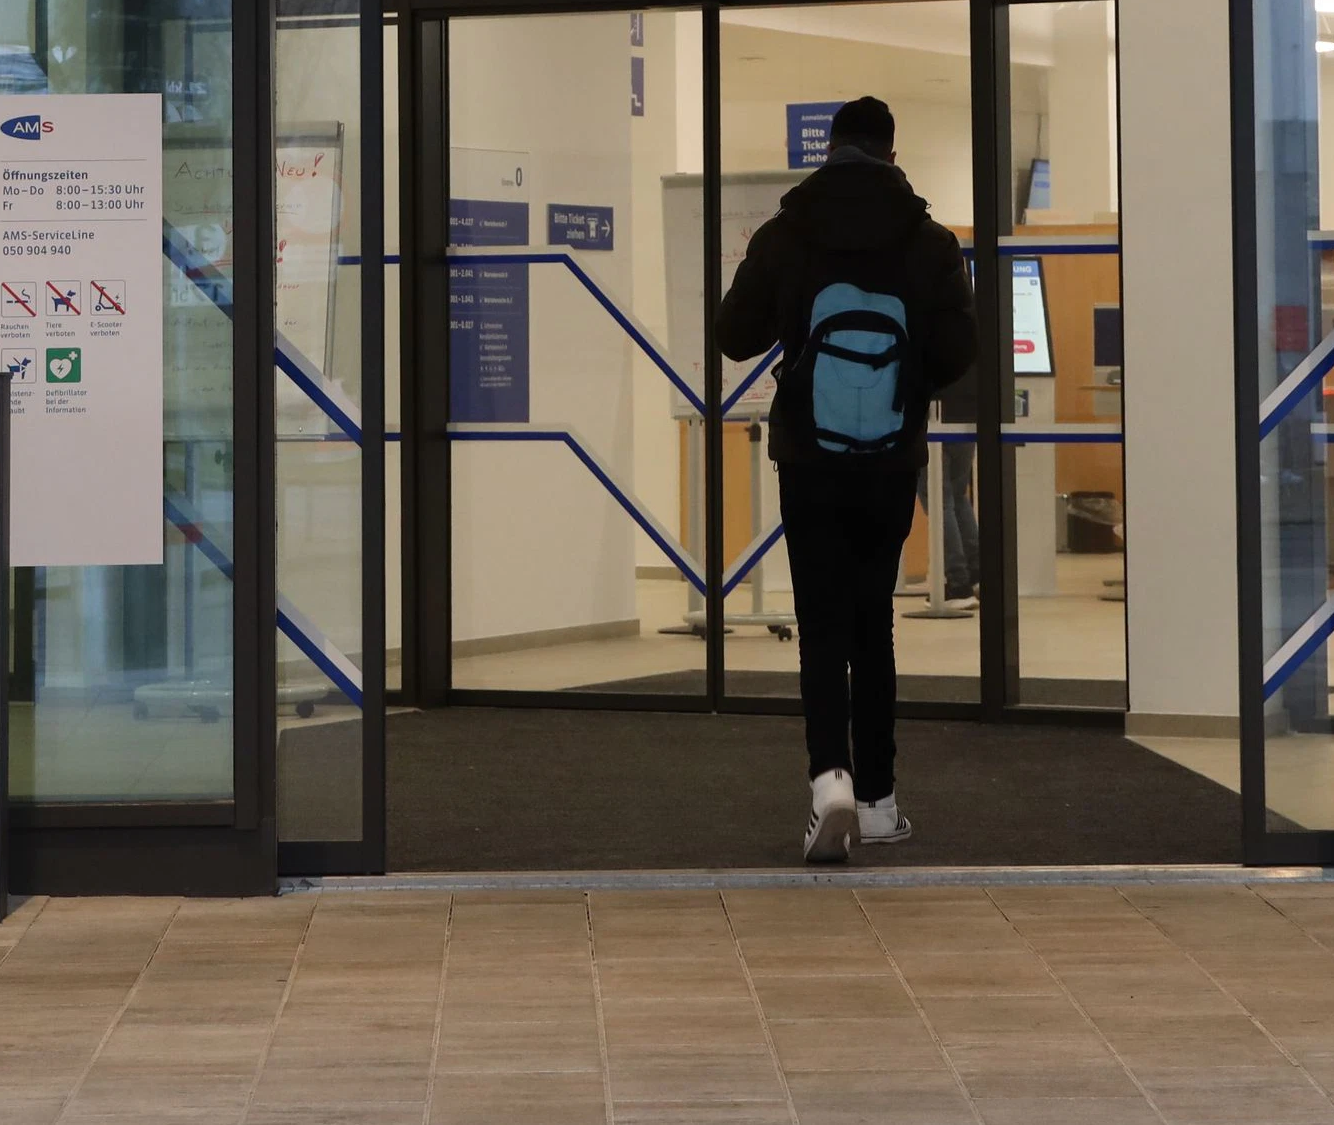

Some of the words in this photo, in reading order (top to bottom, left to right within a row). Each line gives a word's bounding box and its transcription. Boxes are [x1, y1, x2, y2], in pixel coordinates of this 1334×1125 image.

[12, 121, 54, 134] AMS
[801, 128, 825, 138] Bitte
[802, 153, 828, 163] ziehe
[2, 169, 88, 182] Öffnungszeiten
[174, 161, 233, 179] ACHT
[125, 184, 144, 194] Uhr
[2, 201, 13, 211] Fr
[125, 199, 144, 209] Uhr
[568, 213, 585, 224] Ticket
[2, 230, 95, 241] AMS-ServiceLine
[2, 246, 24, 256] 050
[26, 246, 47, 255] 904
[50, 245, 71, 255] 940
